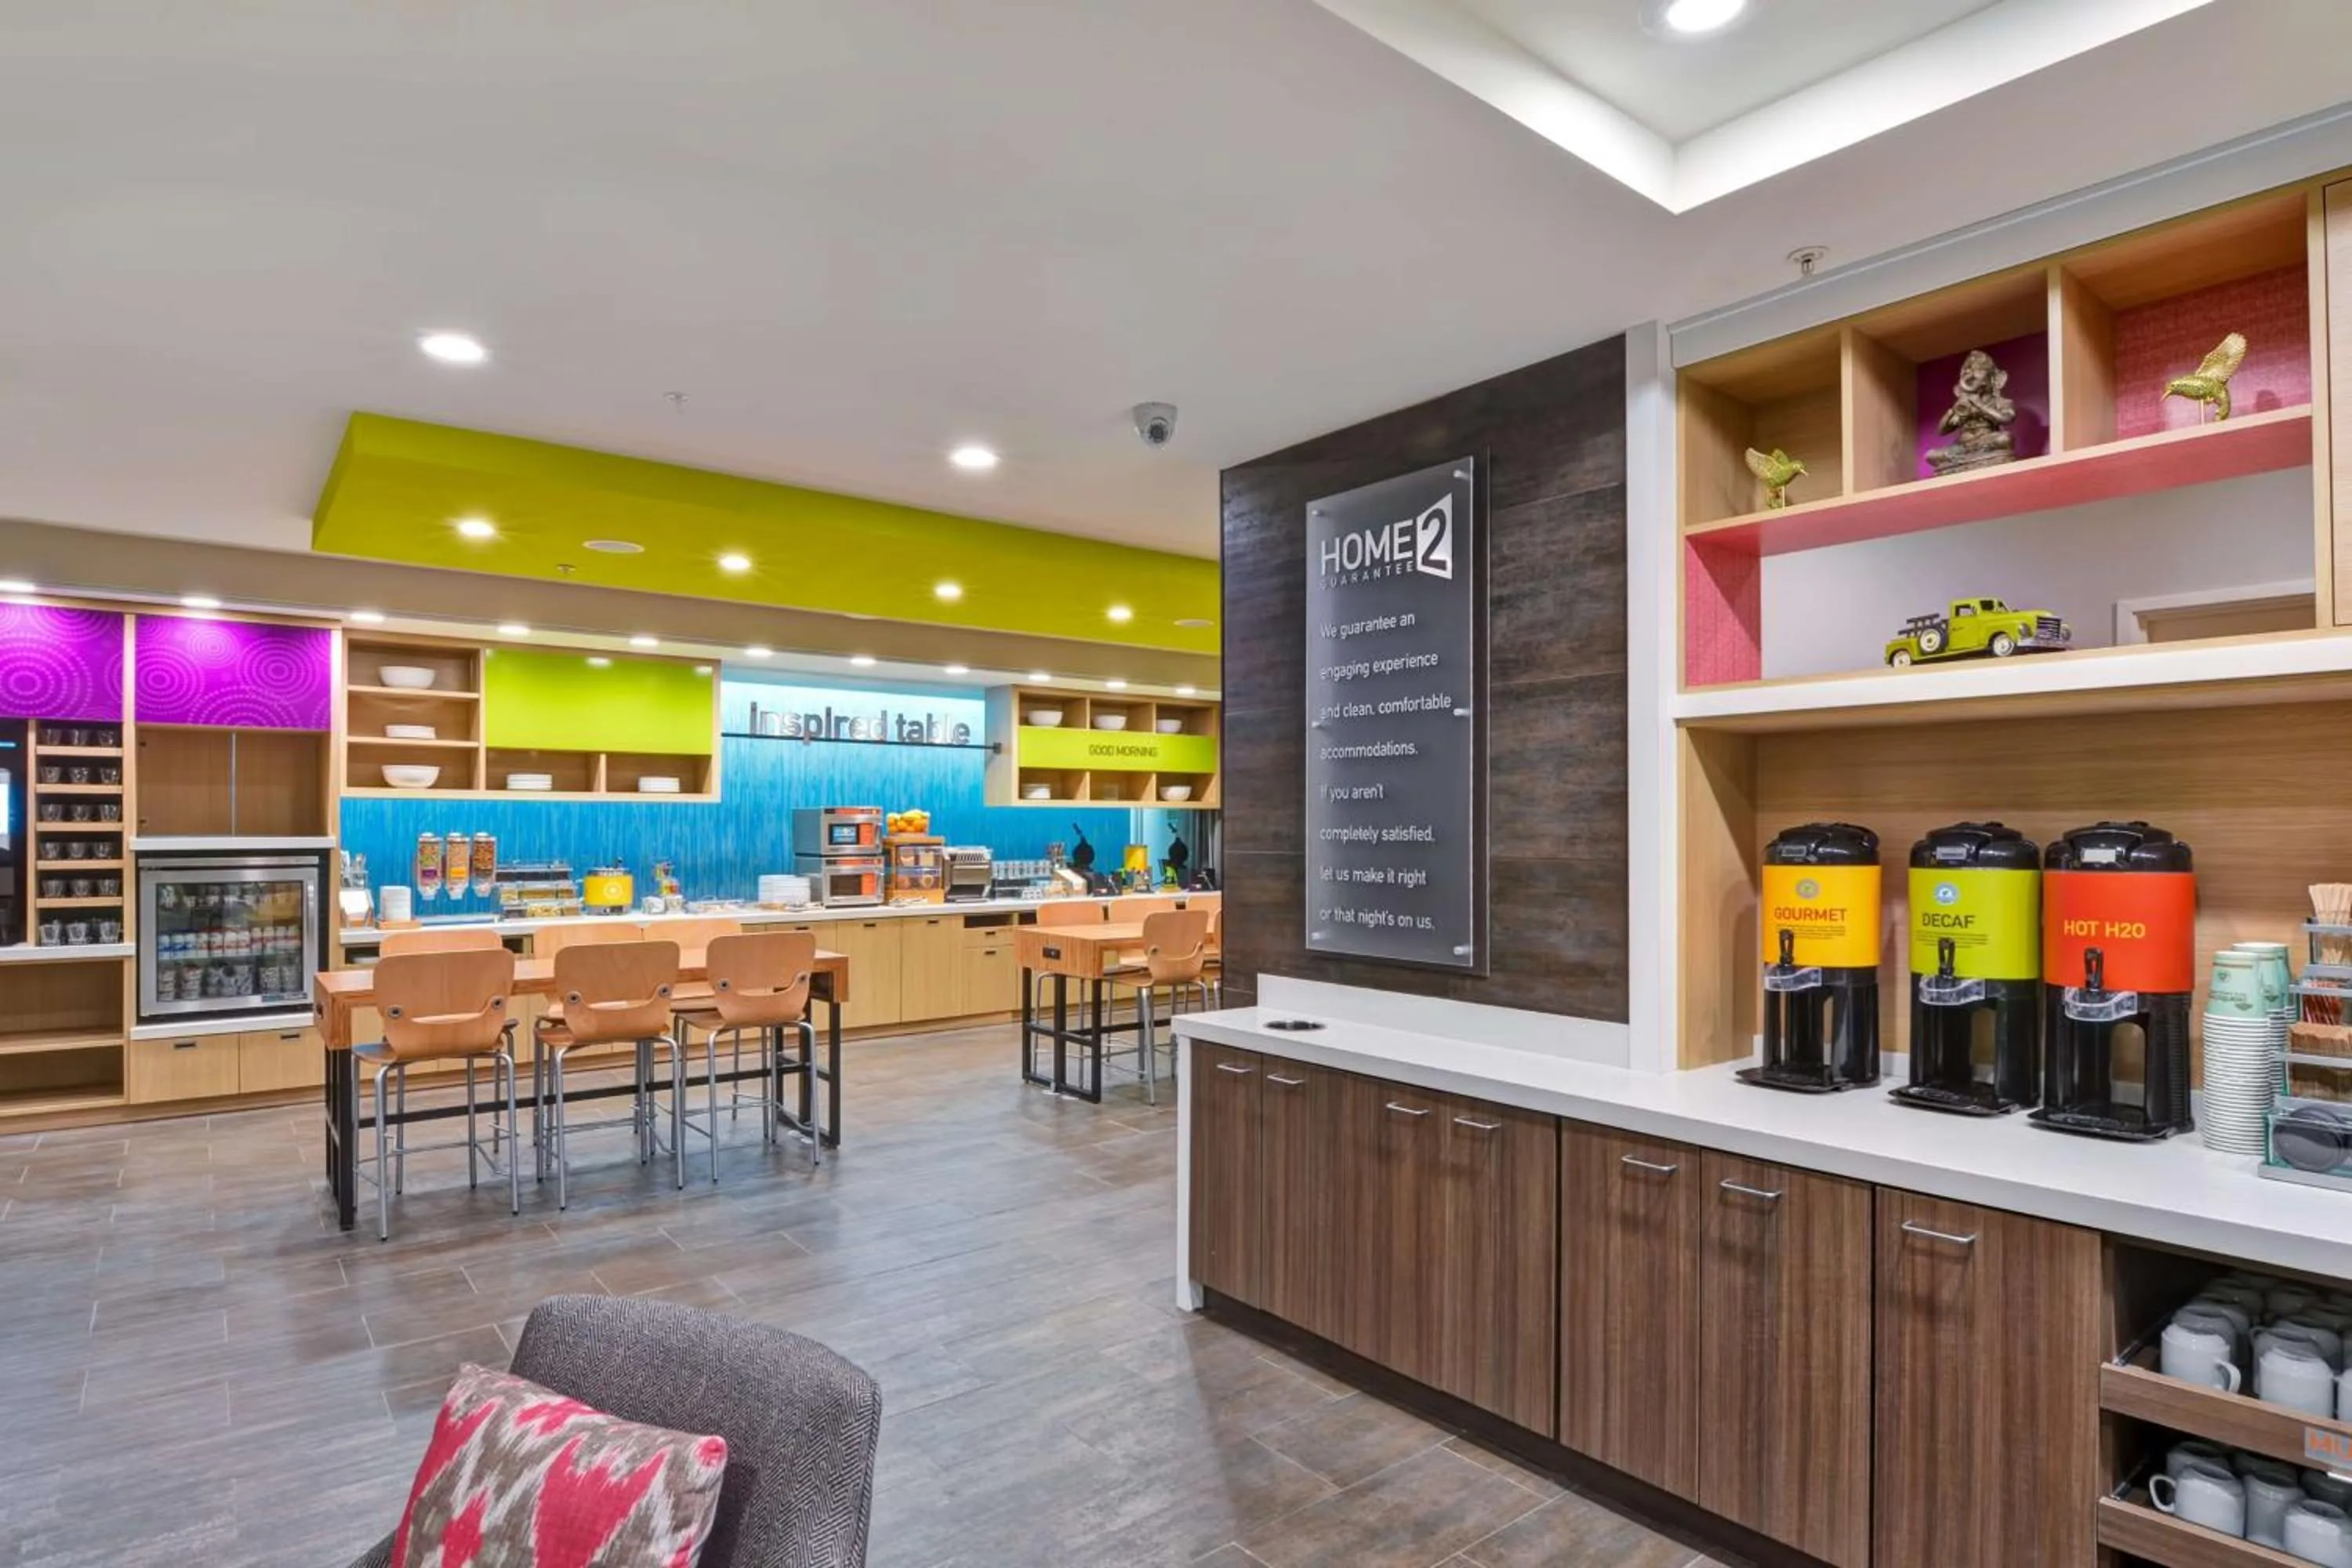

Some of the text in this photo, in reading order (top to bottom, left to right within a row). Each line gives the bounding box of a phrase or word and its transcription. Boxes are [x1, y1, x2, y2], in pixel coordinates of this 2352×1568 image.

[1319, 561, 1414, 590] GUARANTEE
[1320, 613, 1415, 639] We guarantee an
[1320, 652, 1439, 682] engaging experience
[1320, 704, 1340, 719] and
[1377, 692, 1452, 714] comfortable
[895, 713, 971, 745] table
[1089, 744, 1159, 757] GOOD MORNING
[1319, 740, 1418, 760] accommodations.
[1329, 788, 1349, 803] you
[1351, 783, 1385, 800] aren't
[1319, 824, 1380, 844] completely
[1319, 866, 1427, 888] let us make it right
[1319, 905, 1436, 930] or that night's on us.
[1773, 906, 1847, 922] GOURMET
[1922, 912, 1976, 929] DECAF
[2063, 919, 2100, 937] HOT
